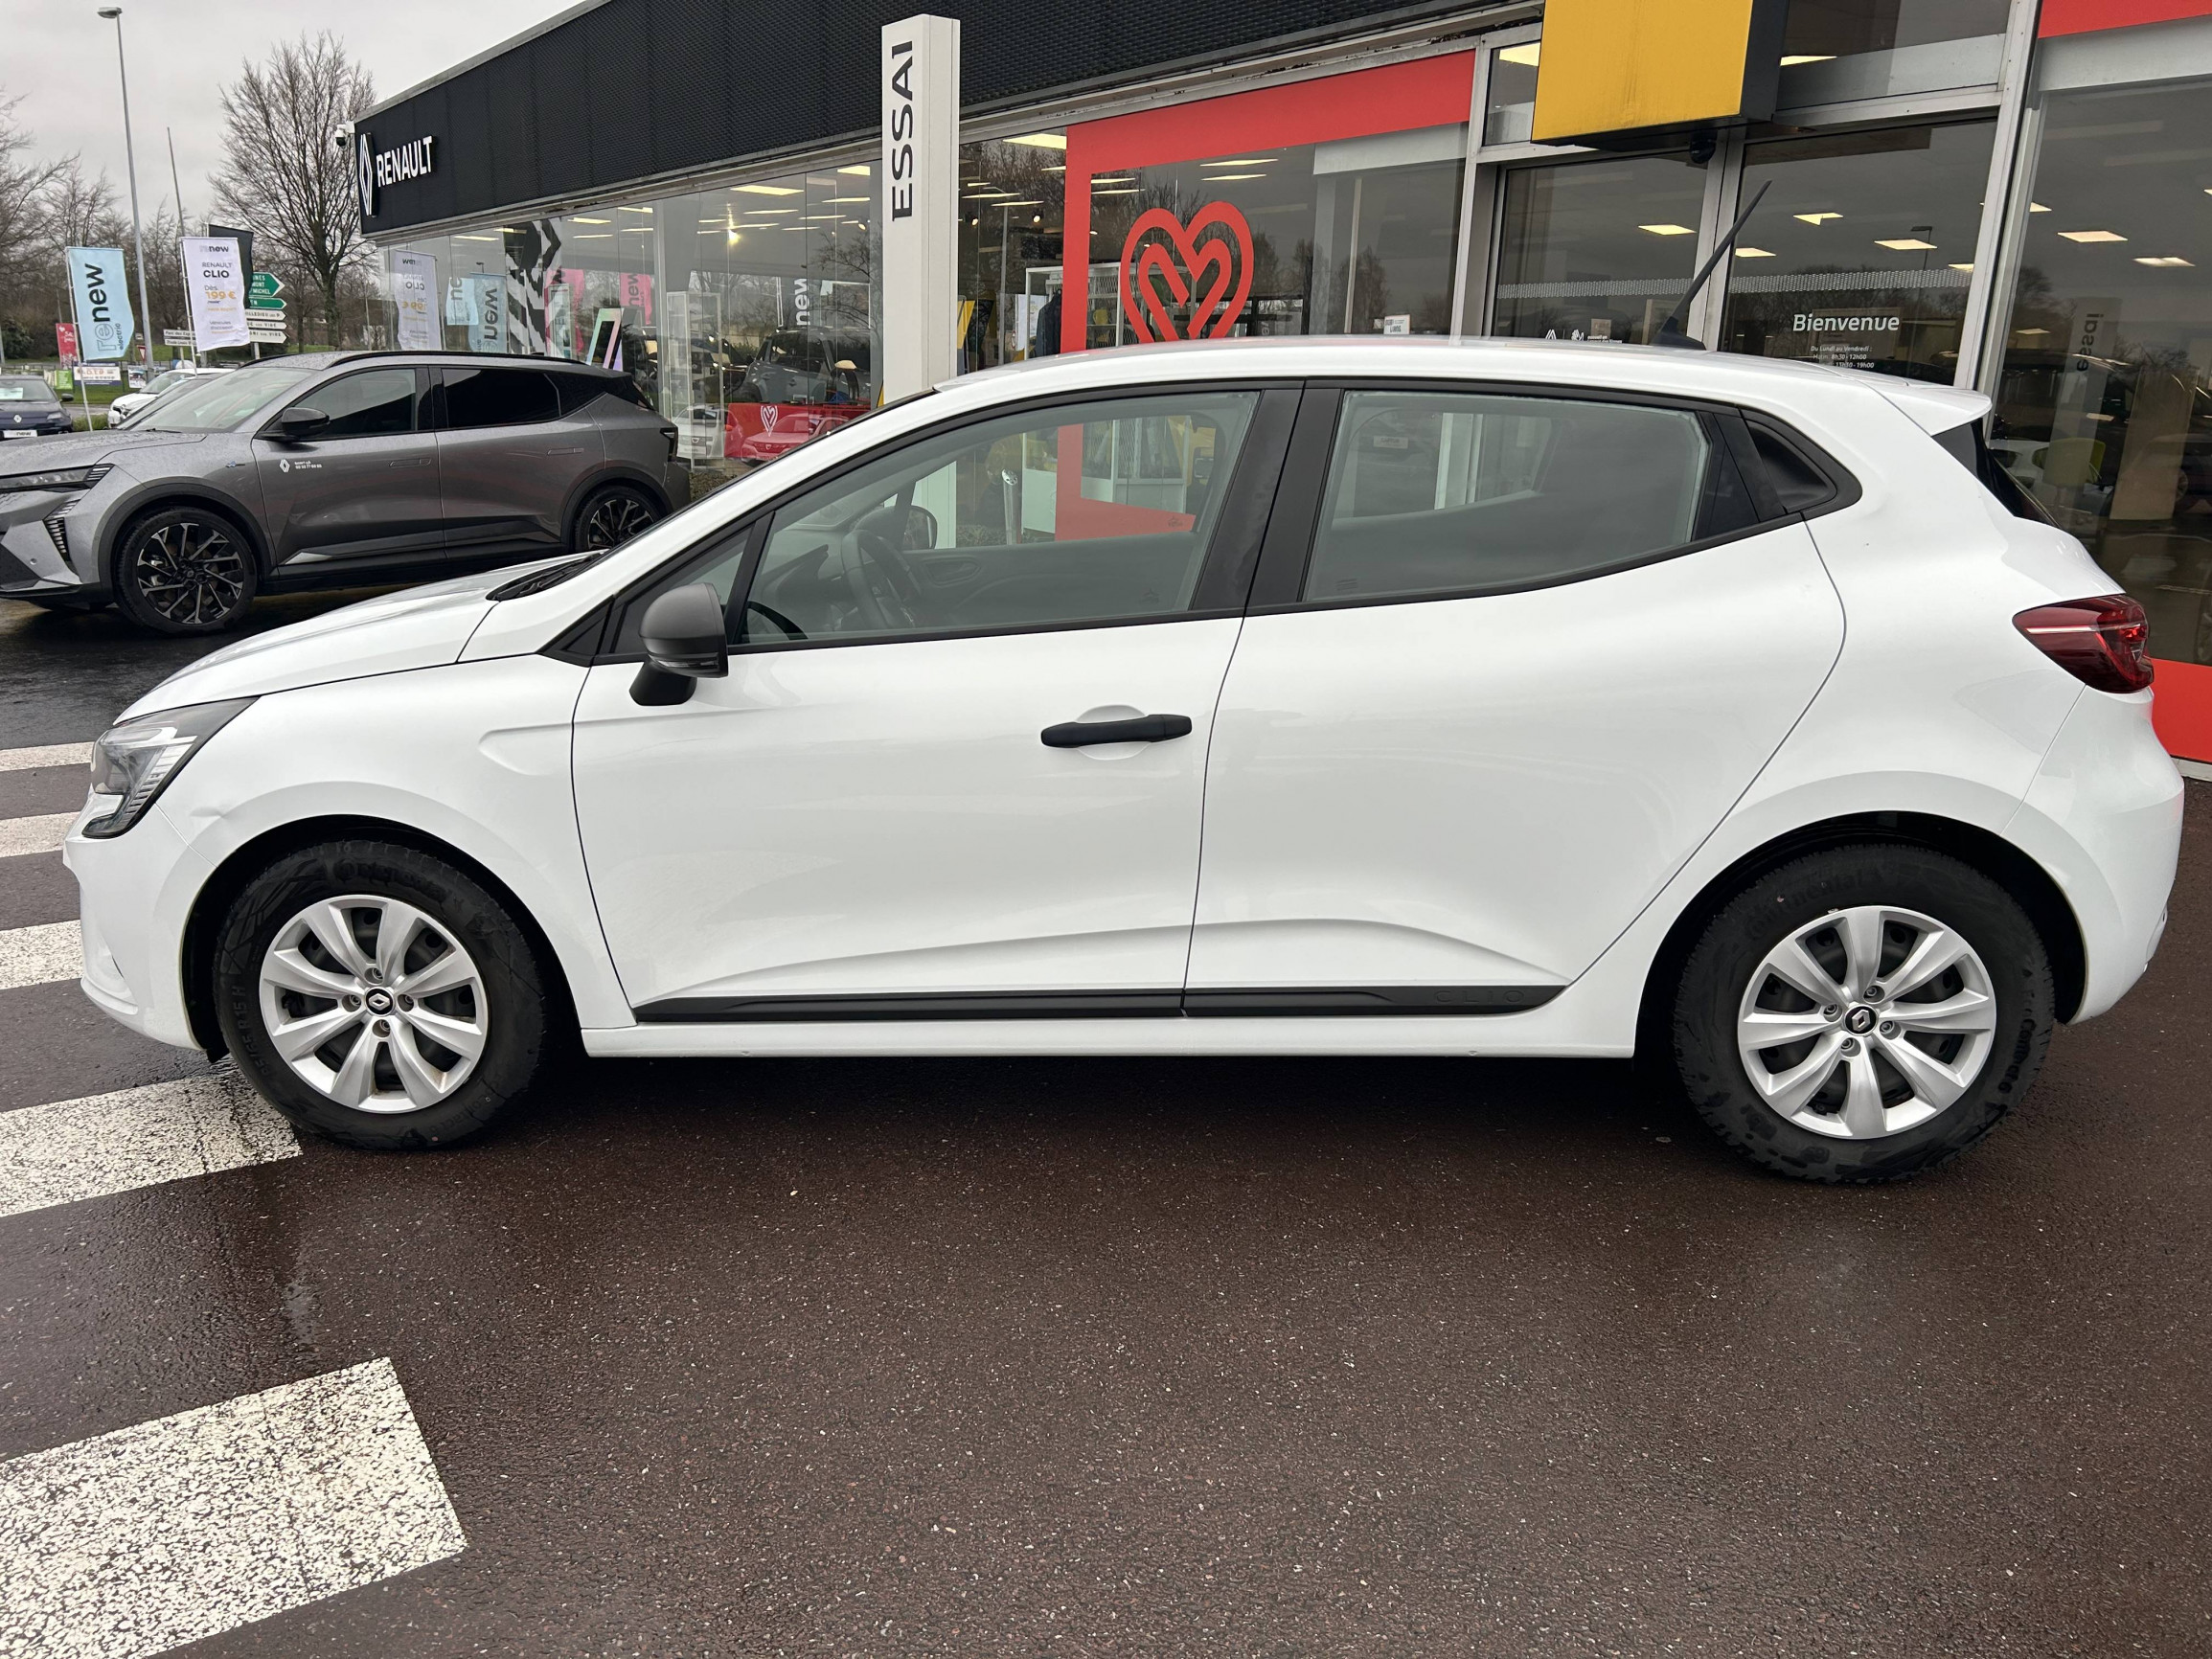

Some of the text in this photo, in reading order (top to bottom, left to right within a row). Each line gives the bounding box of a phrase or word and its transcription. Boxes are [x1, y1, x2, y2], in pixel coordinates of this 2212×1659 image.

[892, 40, 914, 221] ESSAI
[376, 135, 432, 187] RENAULT
[84, 262, 117, 352] renew
[205, 291, 226, 300] 199
[113, 323, 125, 351] electric
[1792, 313, 1900, 331] Bienvenue
